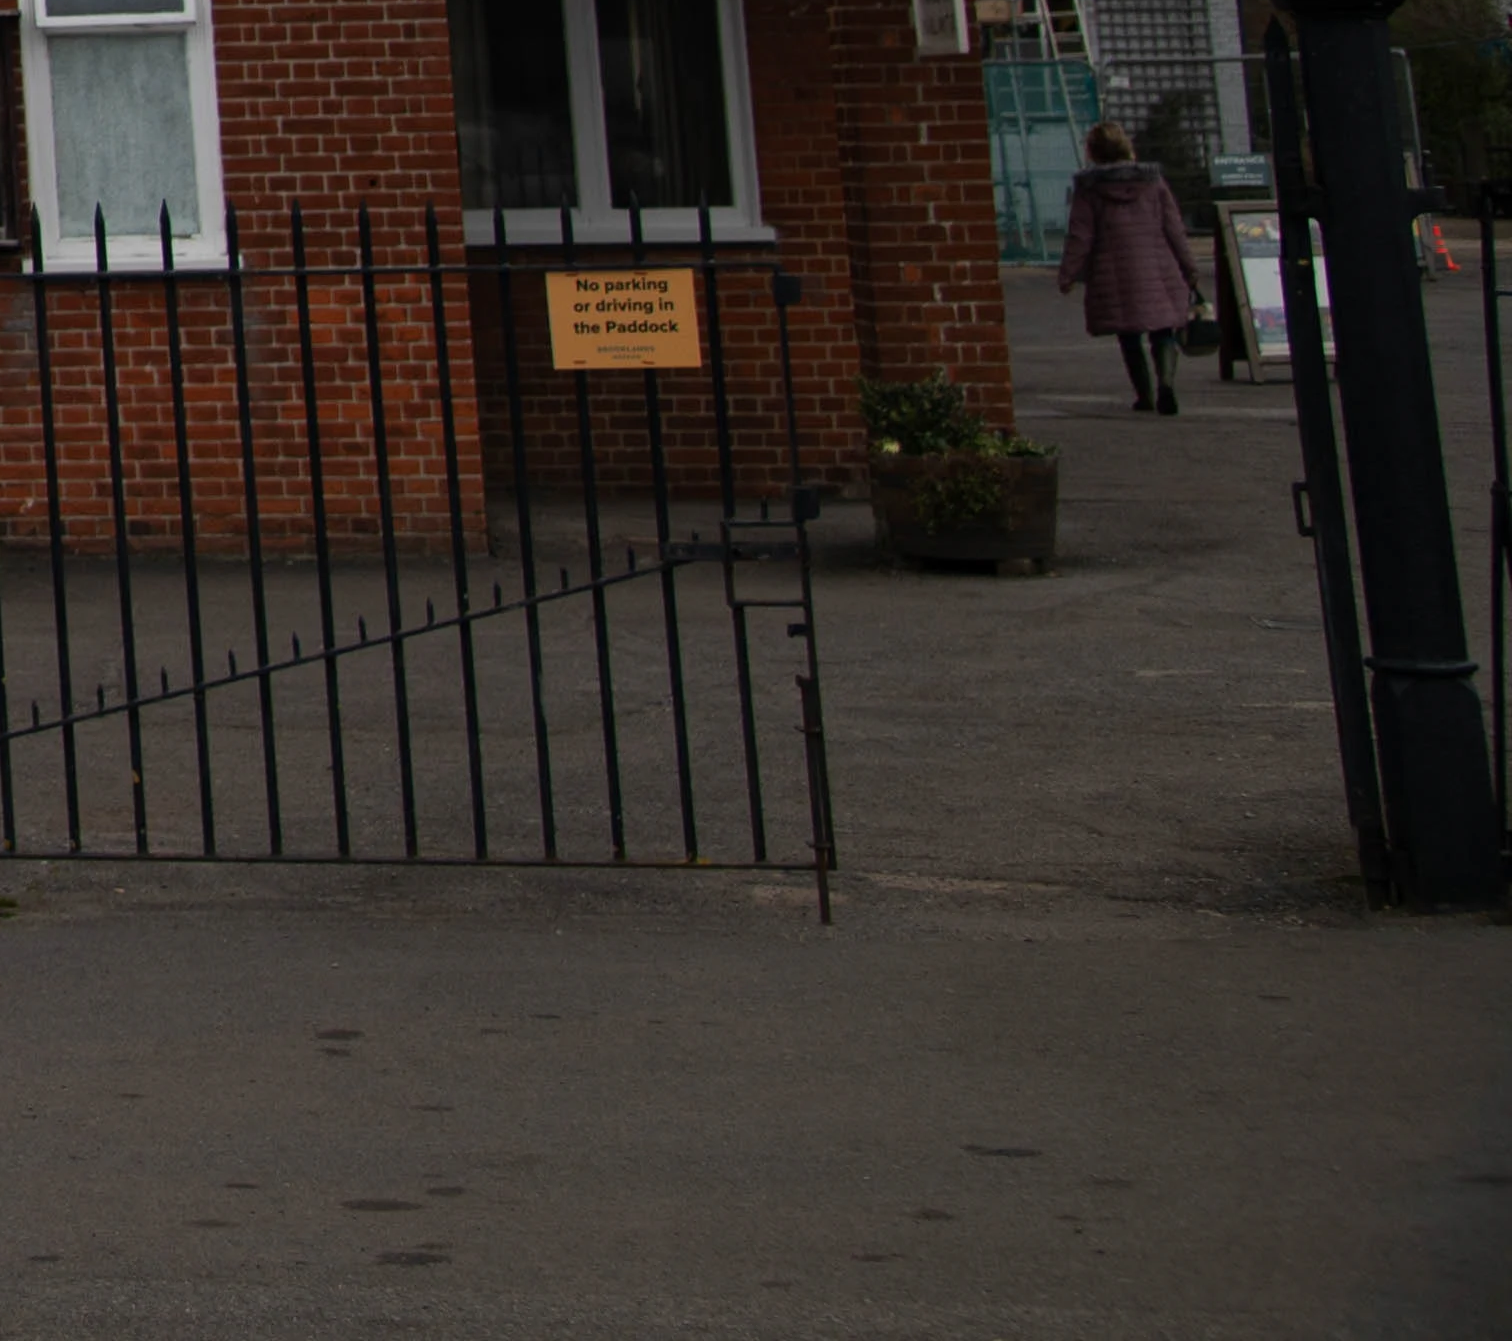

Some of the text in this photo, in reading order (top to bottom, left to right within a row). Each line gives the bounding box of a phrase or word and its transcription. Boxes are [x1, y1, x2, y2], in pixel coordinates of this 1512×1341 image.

[576, 276, 668, 294] No parking
[573, 297, 674, 314] or driving in
[573, 319, 679, 334] the Paddock
